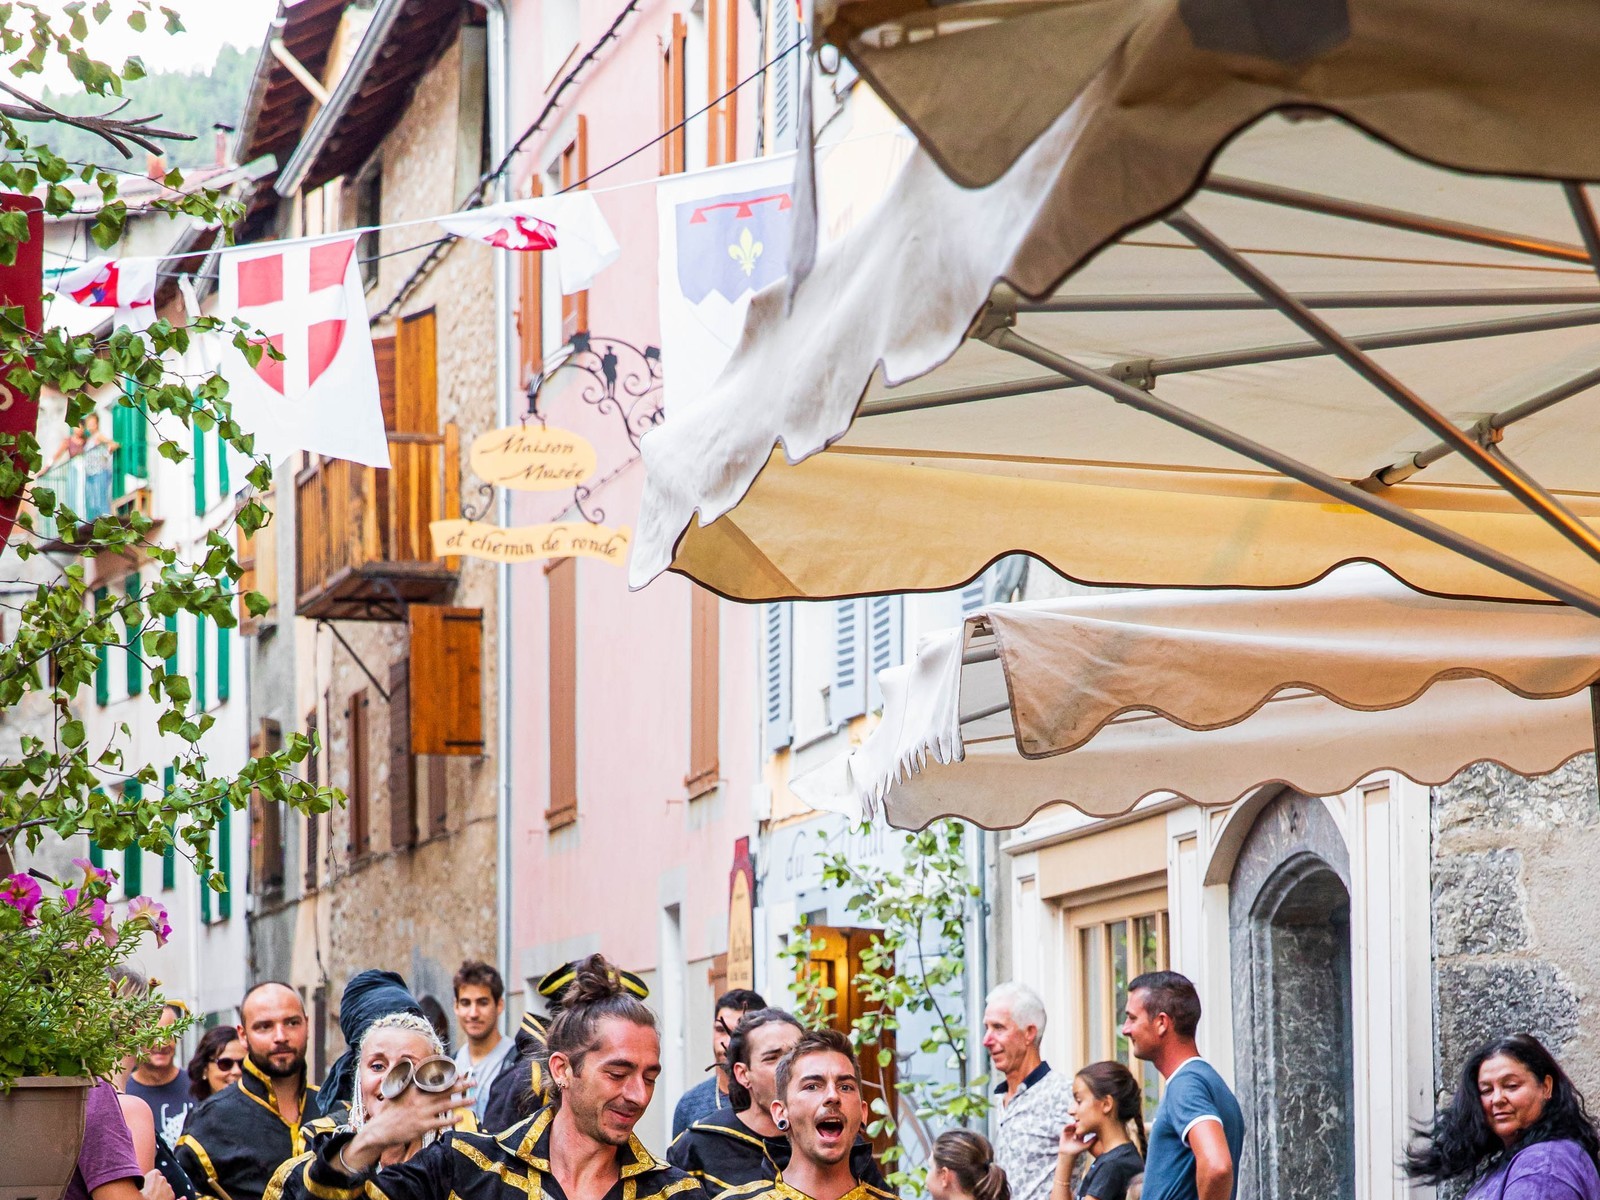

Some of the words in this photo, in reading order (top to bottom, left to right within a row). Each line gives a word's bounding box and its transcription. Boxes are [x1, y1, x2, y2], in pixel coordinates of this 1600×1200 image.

[480, 433, 575, 455] Maison
[499, 463, 585, 481] Musée
[446, 530, 464, 548] et
[472, 530, 534, 556] chemin
[541, 528, 568, 552] de
[571, 534, 627, 558] ronde
